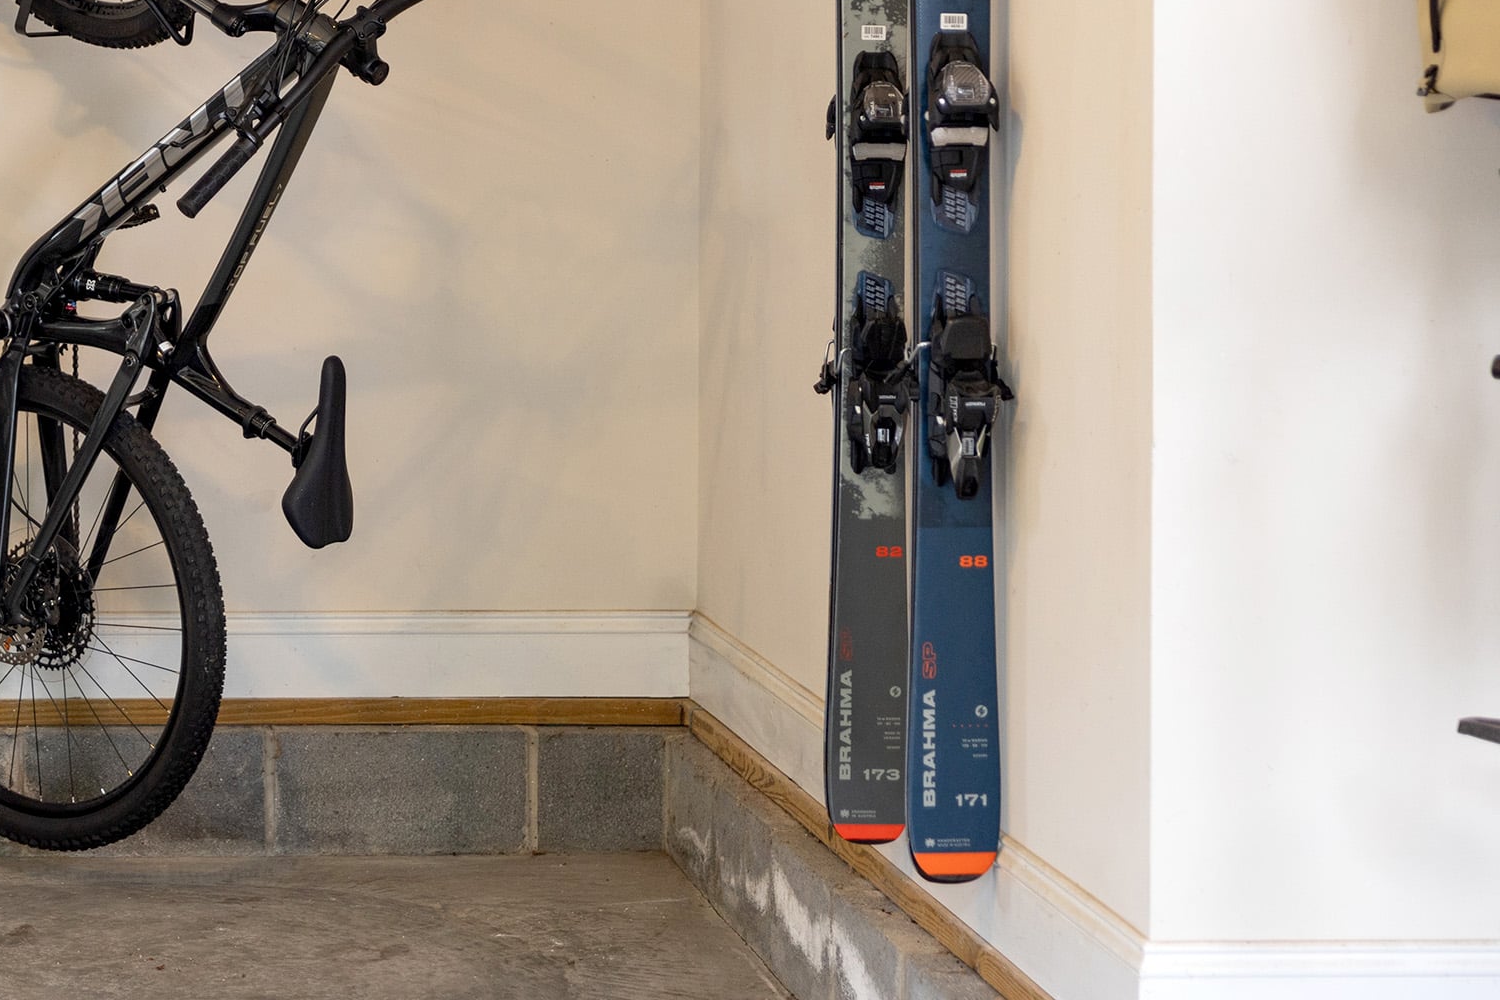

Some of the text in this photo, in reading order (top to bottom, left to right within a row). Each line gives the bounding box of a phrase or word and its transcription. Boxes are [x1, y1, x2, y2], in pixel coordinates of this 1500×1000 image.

[74, 75, 246, 243] TREK
[875, 546, 902, 557] 82
[959, 555, 988, 568] 88
[839, 670, 852, 780] BRAHMA
[922, 641, 936, 807] BRAHMA SP
[863, 769, 900, 781] 173
[955, 794, 988, 806] 171
